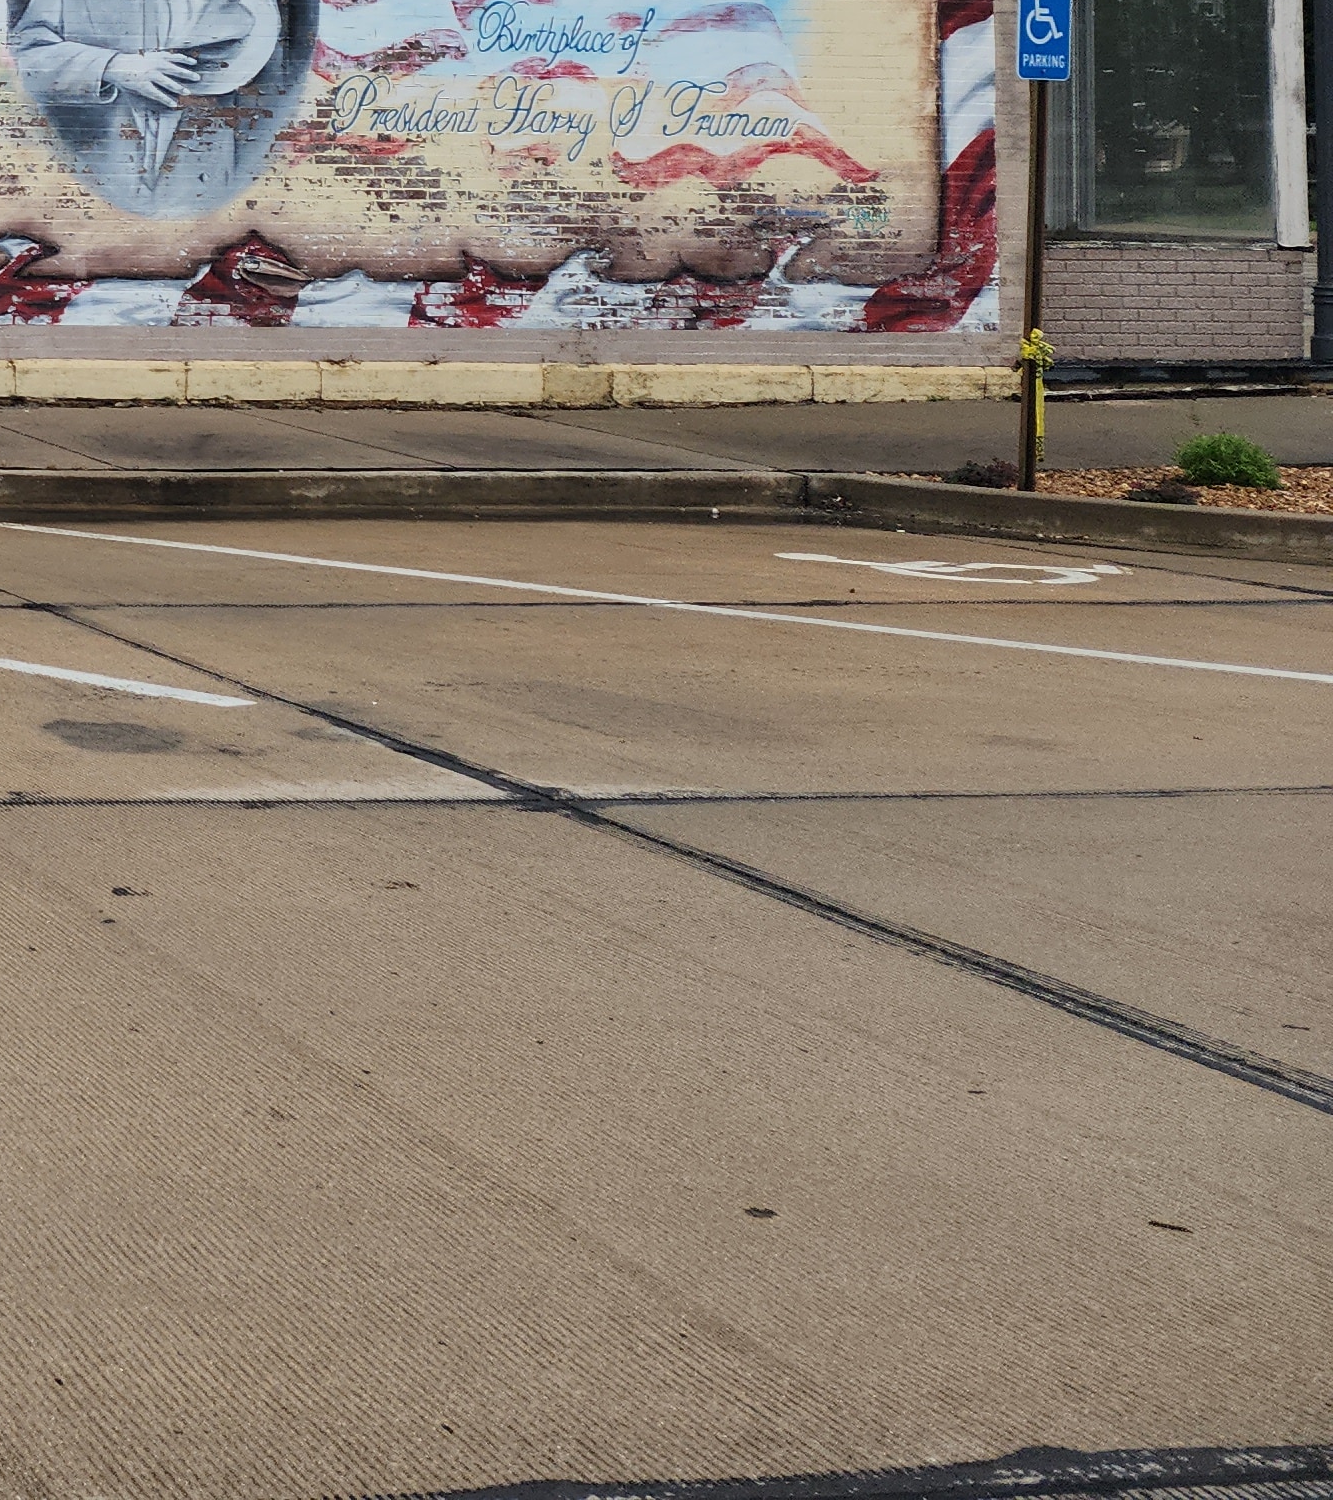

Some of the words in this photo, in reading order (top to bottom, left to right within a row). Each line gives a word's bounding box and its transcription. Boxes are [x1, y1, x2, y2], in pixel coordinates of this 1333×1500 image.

[477, 1, 615, 67] Birthplace
[619, 8, 656, 75] of
[1022, 53, 1066, 69] PARKING
[332, 74, 481, 136] President
[487, 76, 597, 162] Harry
[661, 80, 795, 138] Truman
